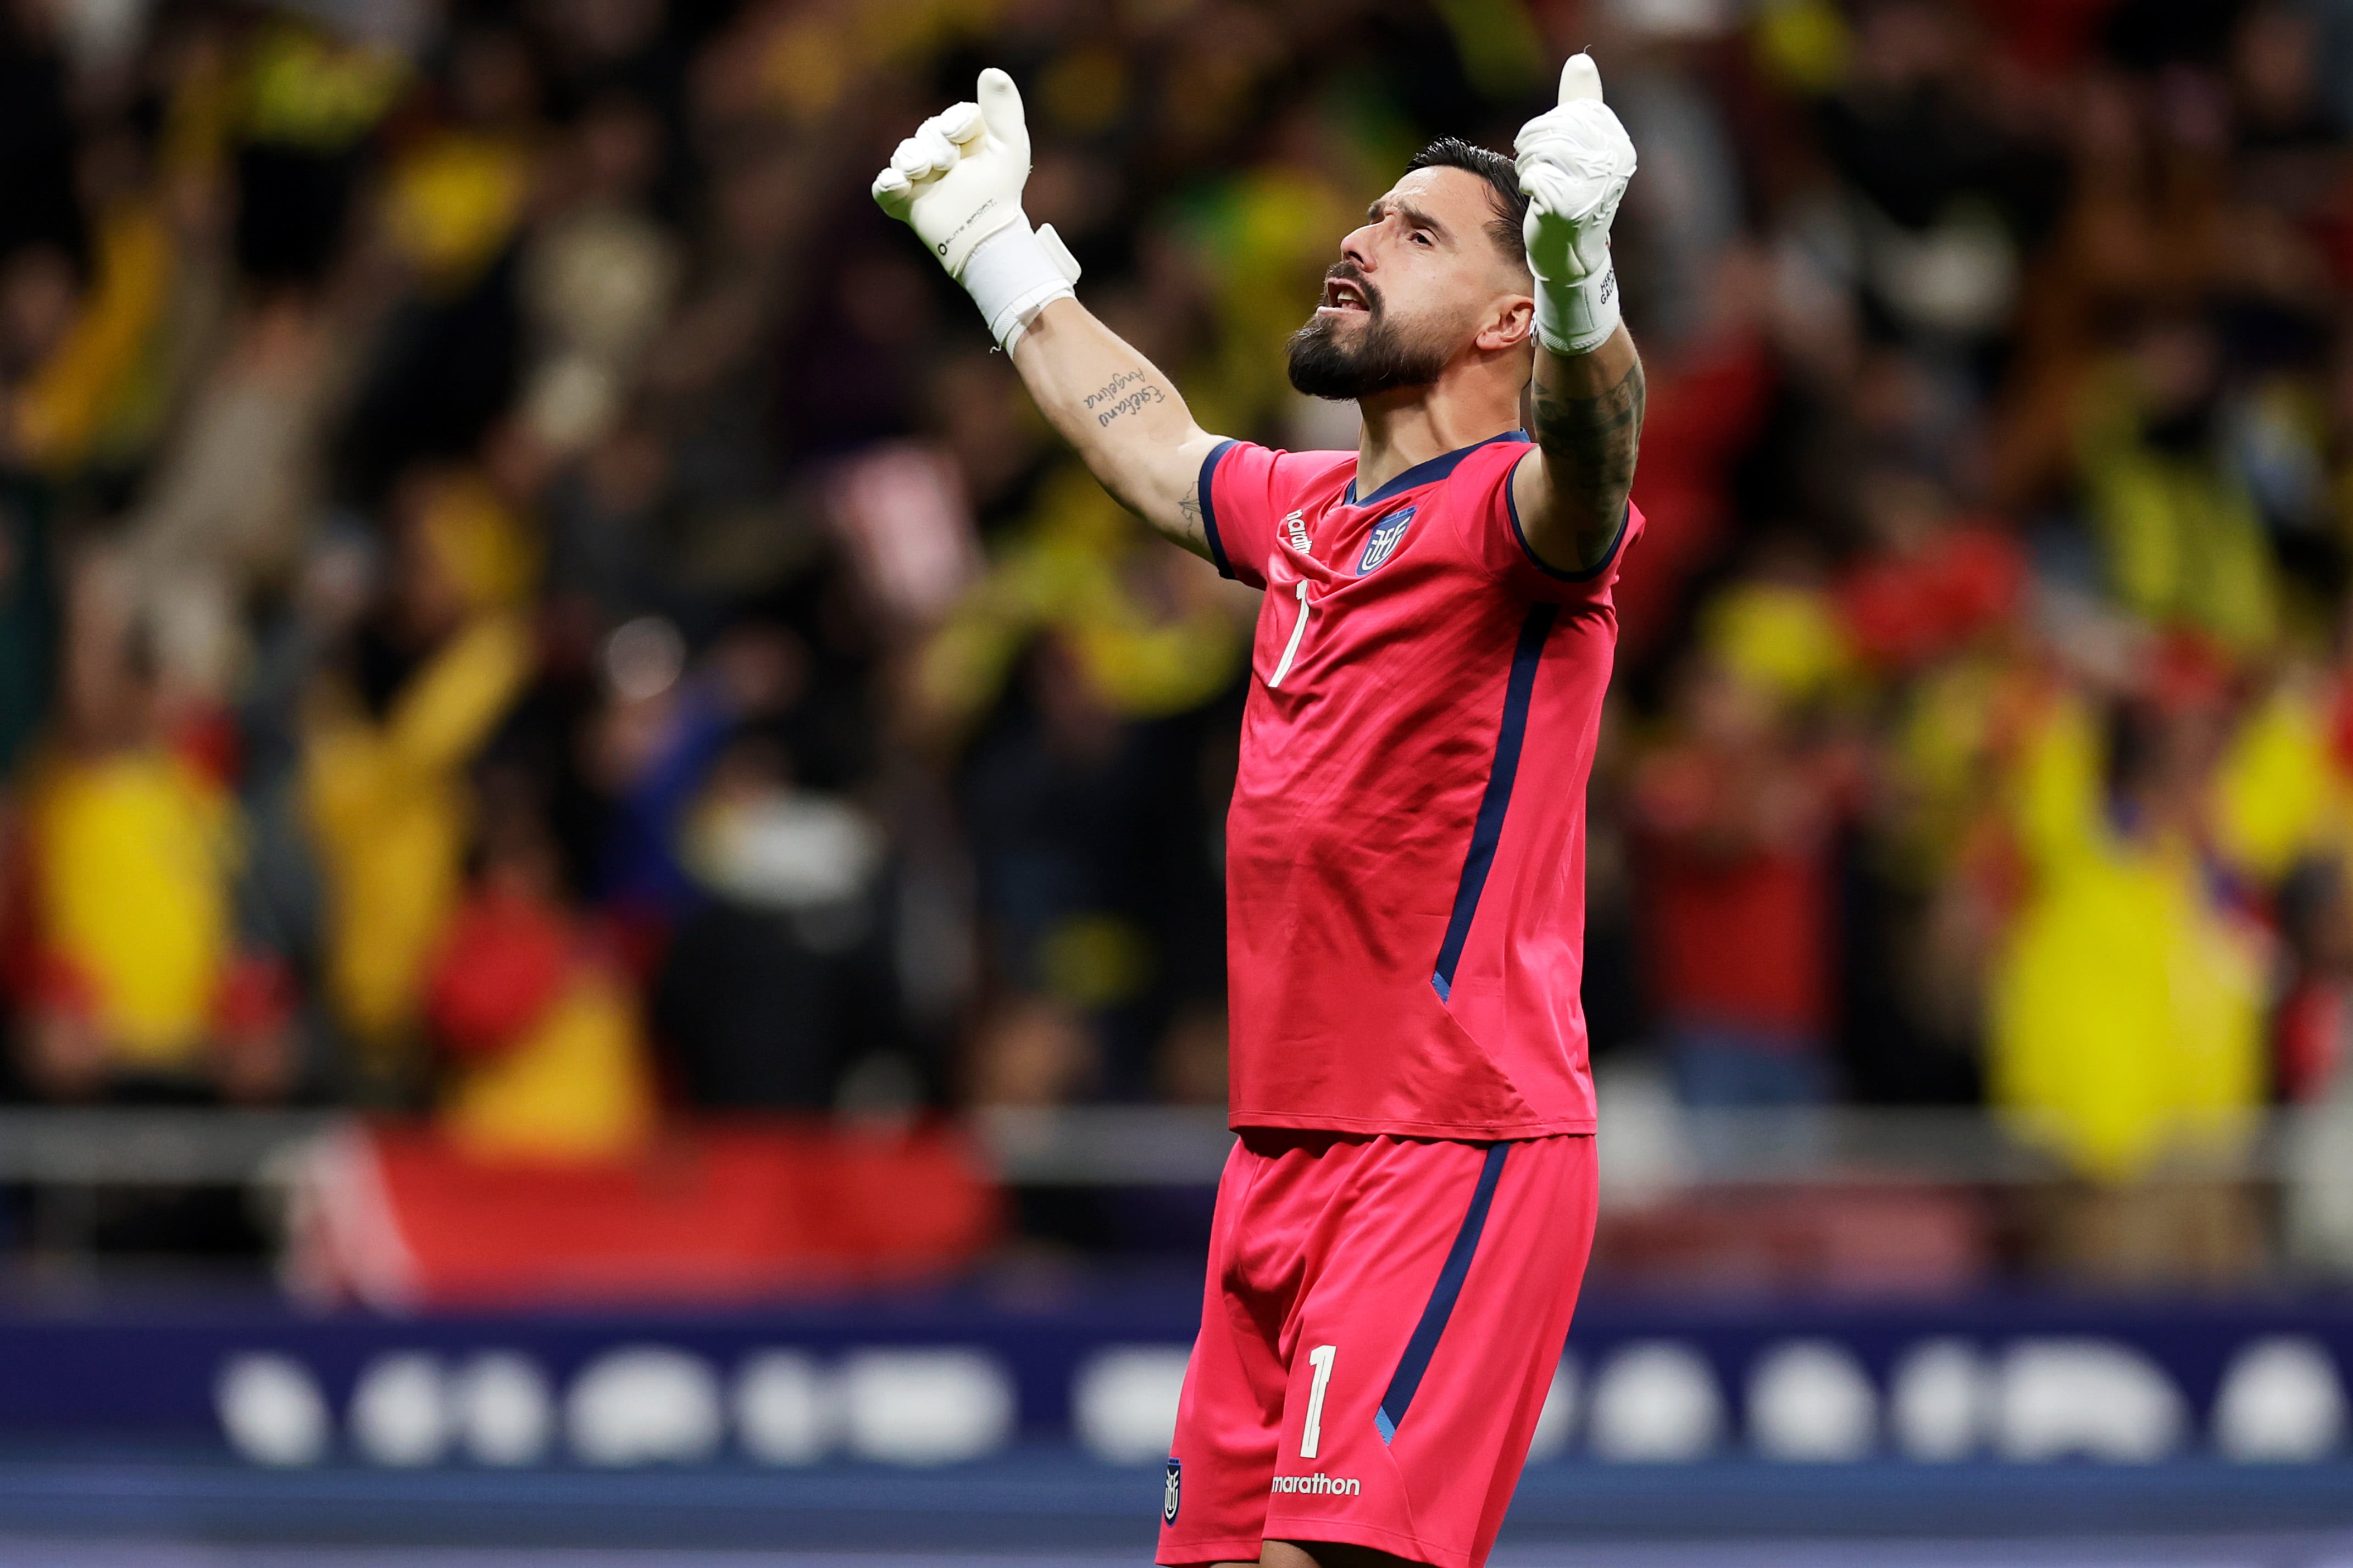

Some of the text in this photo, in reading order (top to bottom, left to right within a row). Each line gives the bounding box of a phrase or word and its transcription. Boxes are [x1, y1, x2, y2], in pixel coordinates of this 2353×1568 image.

[966, 198, 993, 224] SPORT
[1083, 368, 1146, 409] Angelina
[1267, 579, 1309, 687] 1
[1300, 1344, 1337, 1459] 1
[1270, 1472, 1361, 1496] marathon
